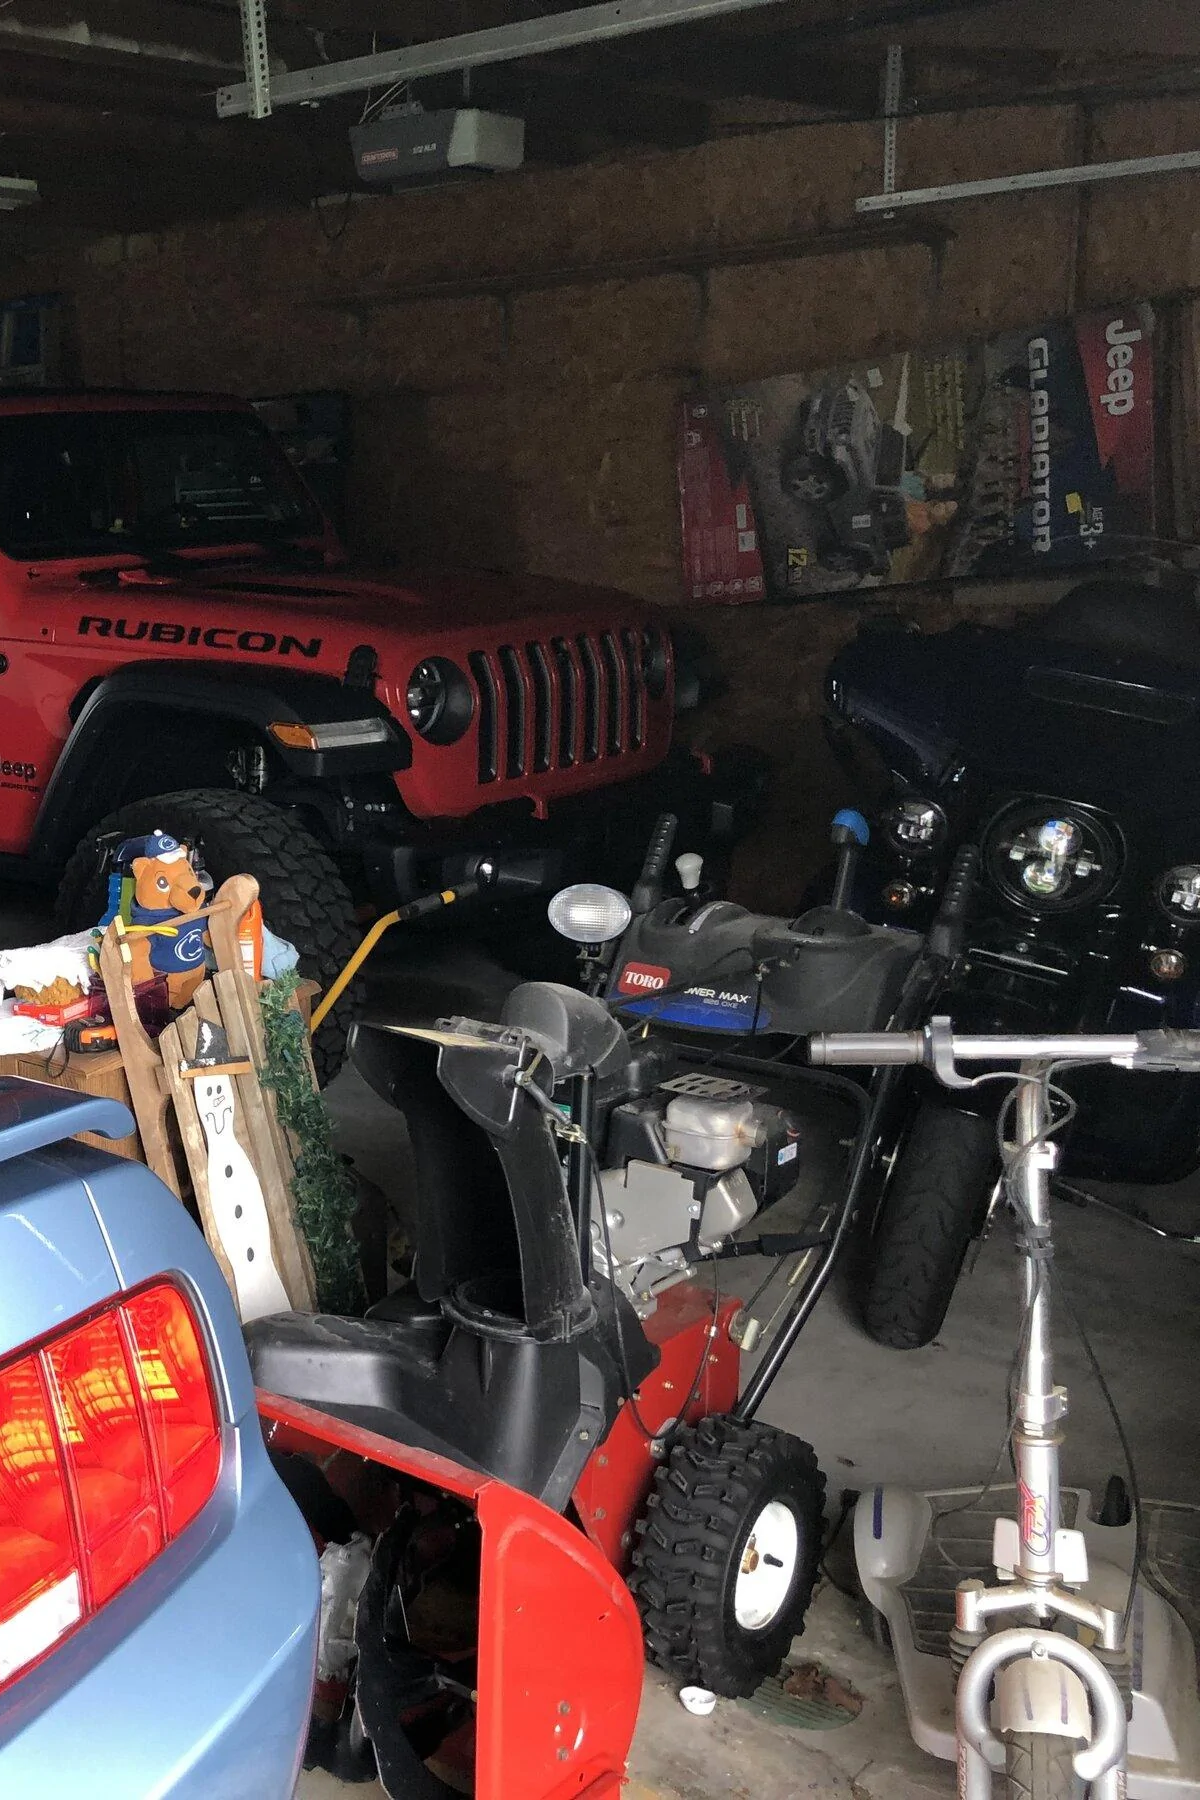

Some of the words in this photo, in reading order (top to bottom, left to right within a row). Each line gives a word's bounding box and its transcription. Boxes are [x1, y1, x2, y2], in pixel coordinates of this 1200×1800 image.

[1100, 319, 1141, 416] Jeep
[1028, 337, 1050, 552] GLADIATOR
[78, 616, 322, 657] RUBICON
[625, 971, 664, 989] TORO
[684, 987, 716, 999] WER
[718, 991, 749, 1004] MAX
